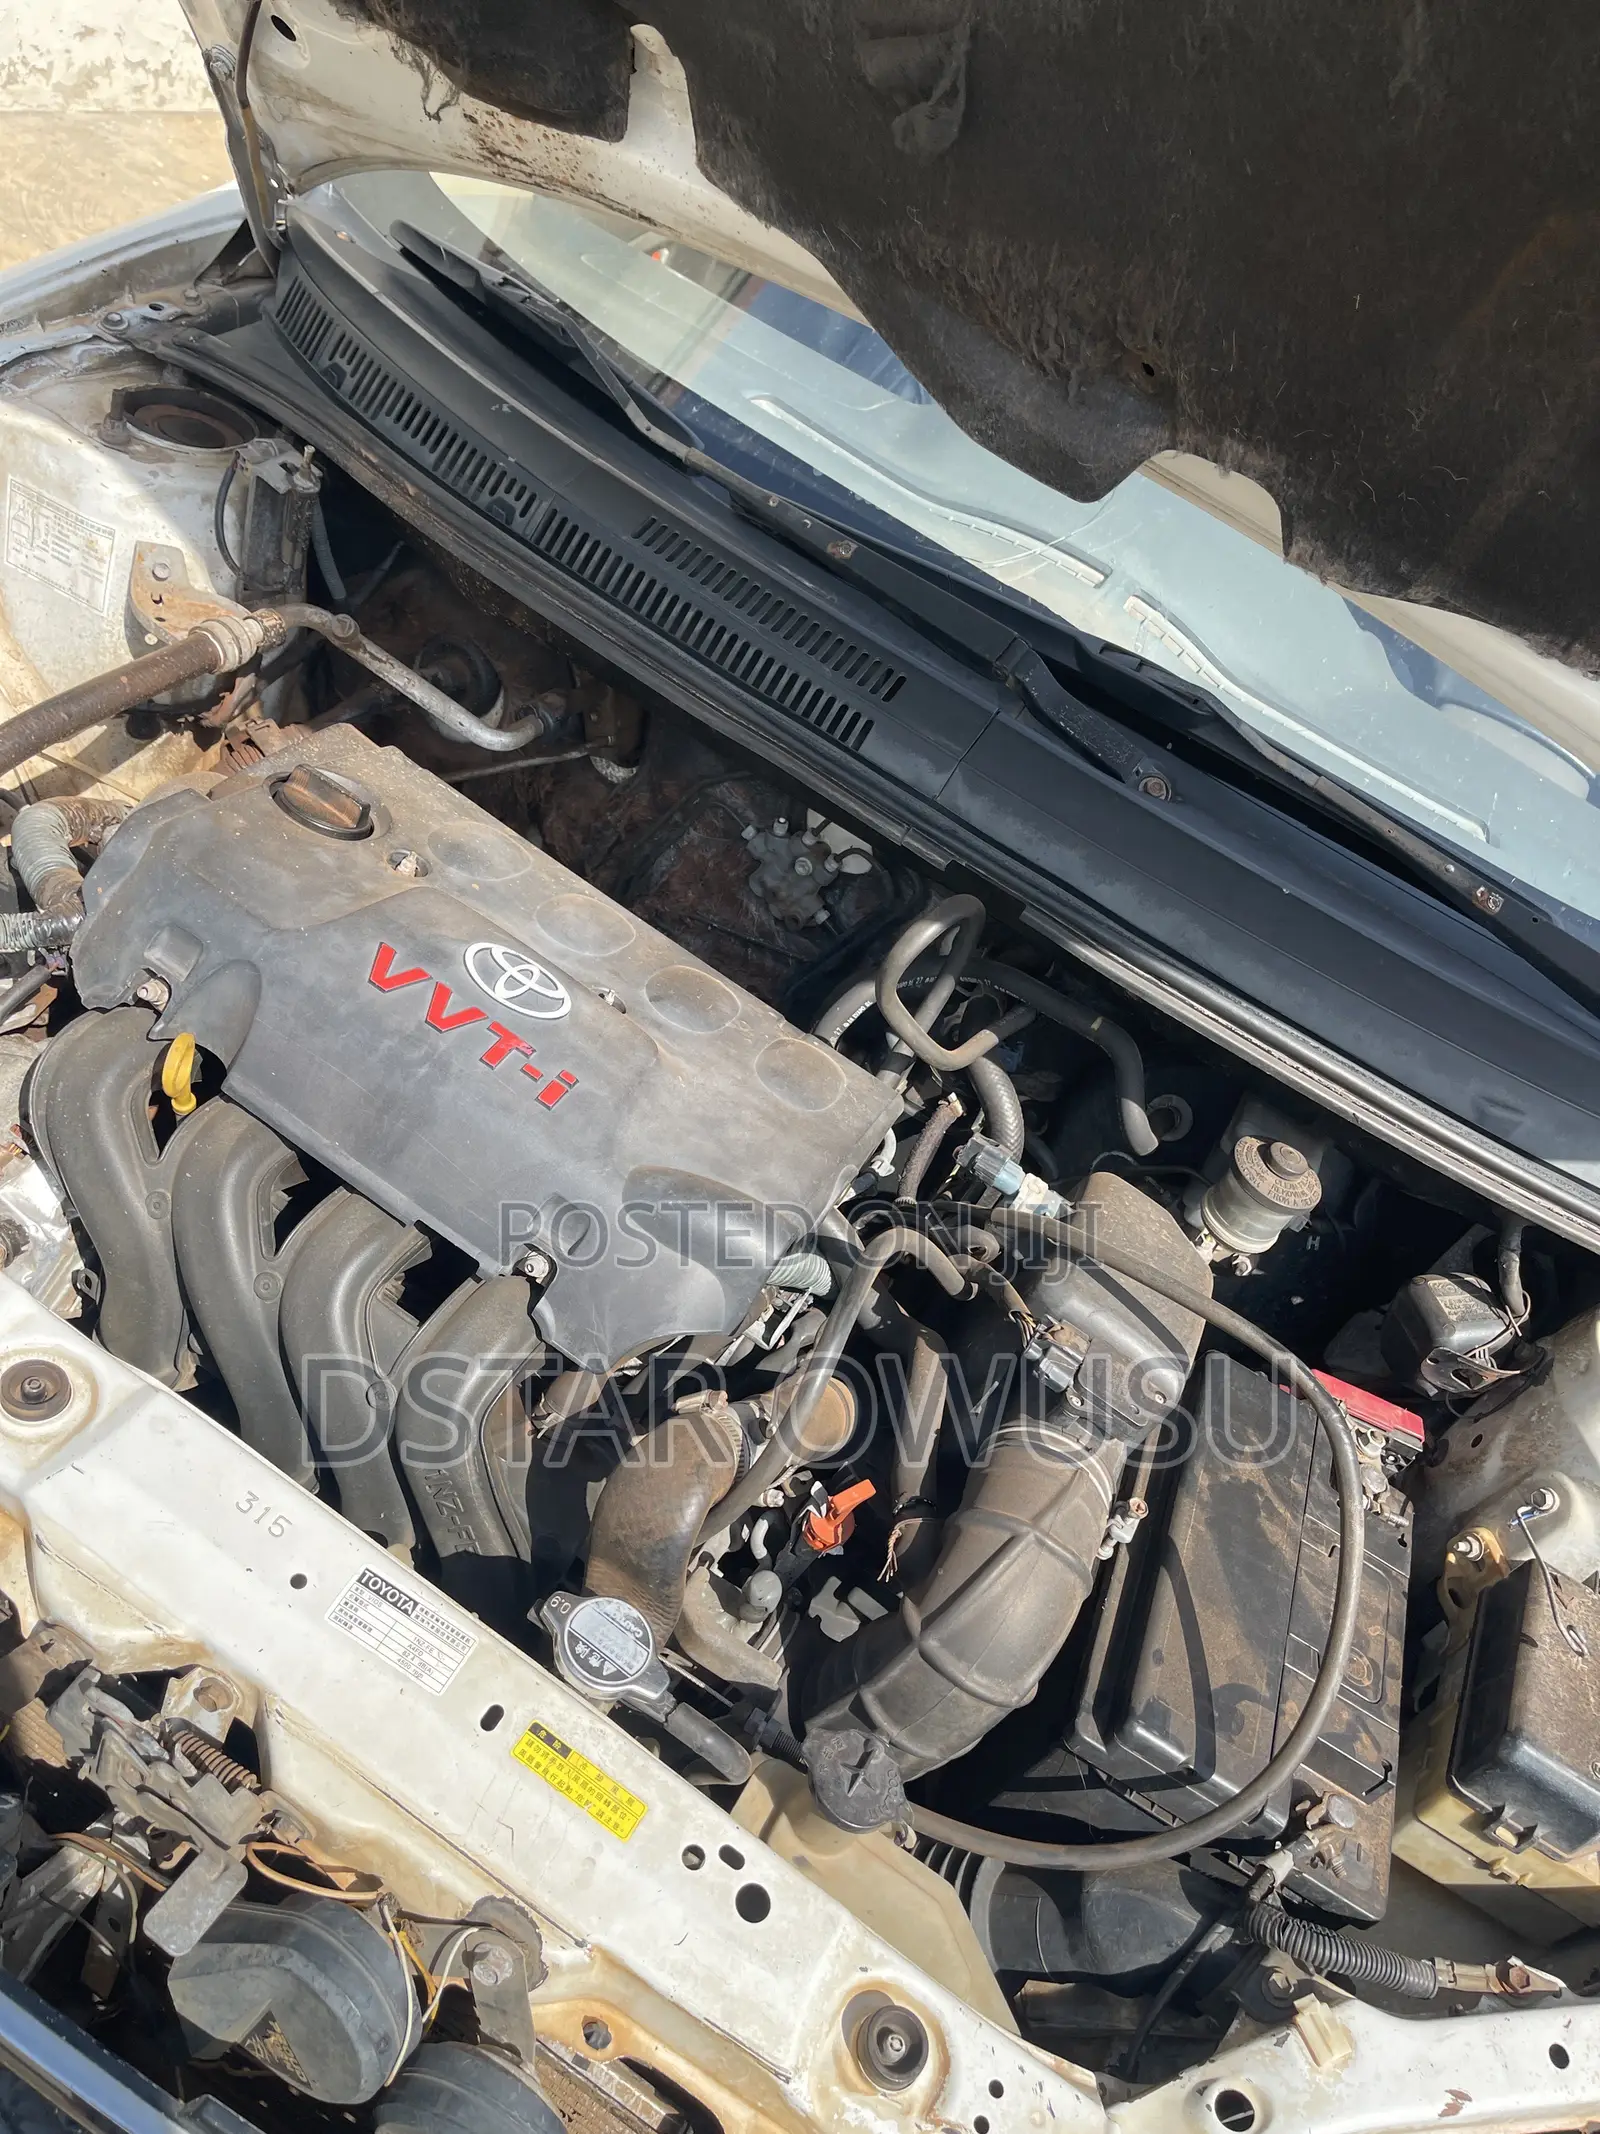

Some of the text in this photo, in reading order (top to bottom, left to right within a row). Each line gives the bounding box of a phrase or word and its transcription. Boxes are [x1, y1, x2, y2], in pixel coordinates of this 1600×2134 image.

[367, 942, 578, 1110] VVT-i
[234, 1490, 294, 1538] 315
[359, 1570, 415, 1614] TOYOTA
[549, 1594, 572, 1615] 0.9
